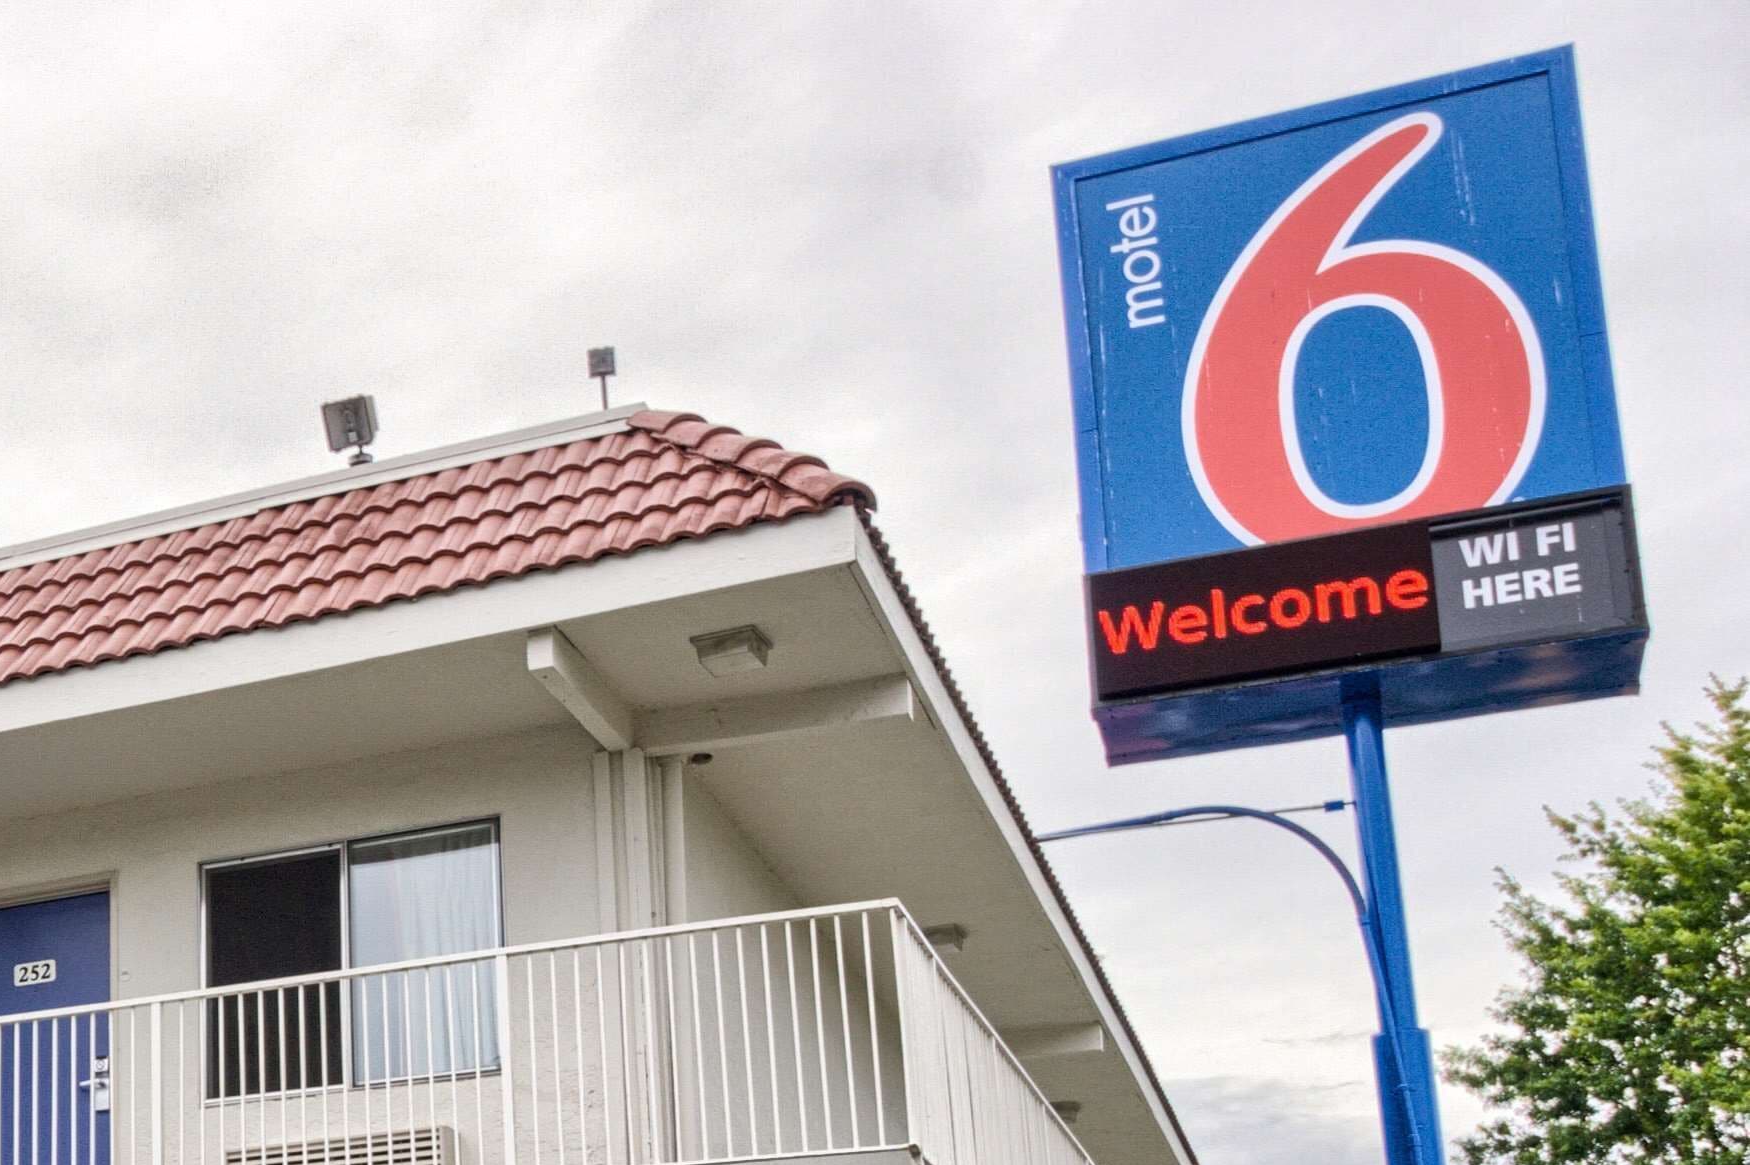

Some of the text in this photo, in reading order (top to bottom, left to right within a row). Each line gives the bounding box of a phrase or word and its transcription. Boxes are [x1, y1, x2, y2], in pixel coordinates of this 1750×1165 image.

[1106, 194, 1165, 328] motel
[1181, 111, 1546, 546] 6
[1458, 523, 1578, 568] WI FI
[1098, 567, 1430, 655] Welcome
[1461, 563, 1583, 609] HERE
[18, 963, 51, 983] 252
